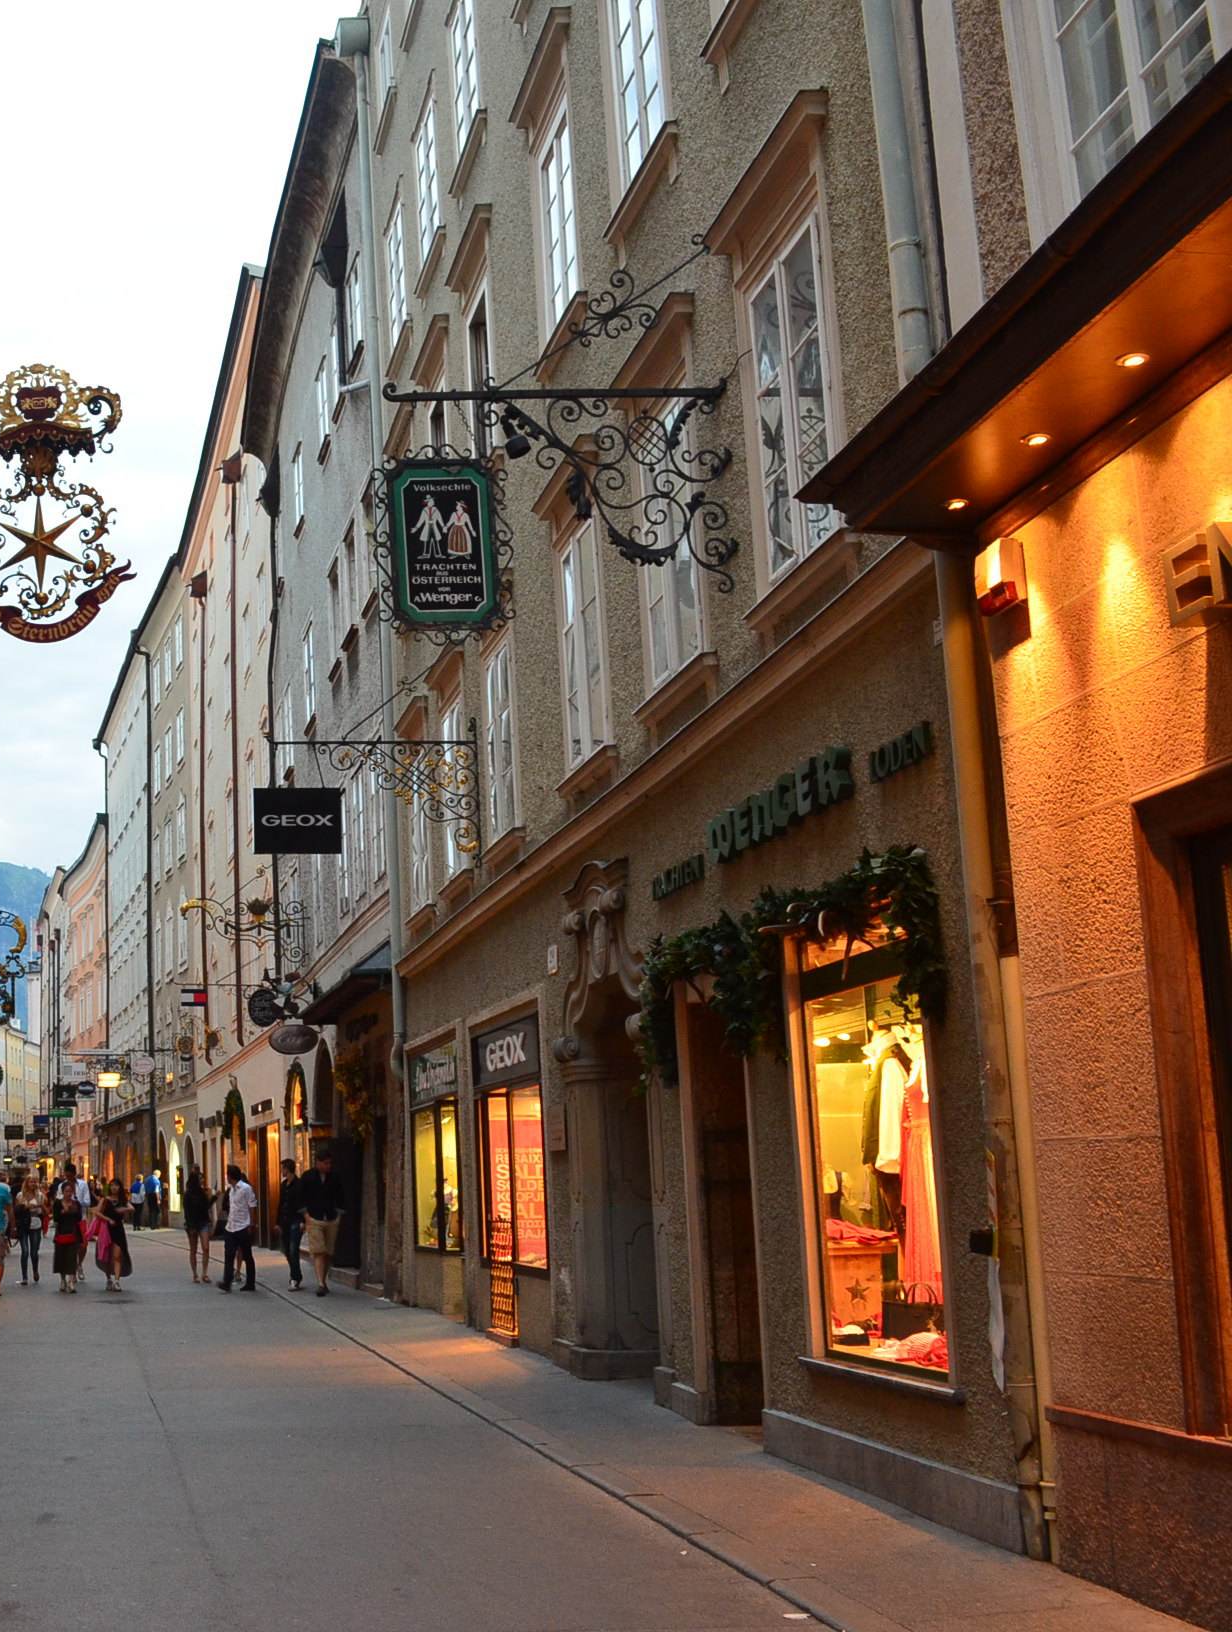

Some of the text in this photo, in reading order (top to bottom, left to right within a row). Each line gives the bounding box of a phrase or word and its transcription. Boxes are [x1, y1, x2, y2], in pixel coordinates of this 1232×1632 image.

[413, 483, 472, 492] Volksechte
[414, 563, 477, 571] TRACHTEN
[420, 592, 472, 605] Wenger
[7, 604, 96, 641] Sternbräu
[261, 814, 334, 827] GEOX
[485, 1031, 526, 1073] GEOX
